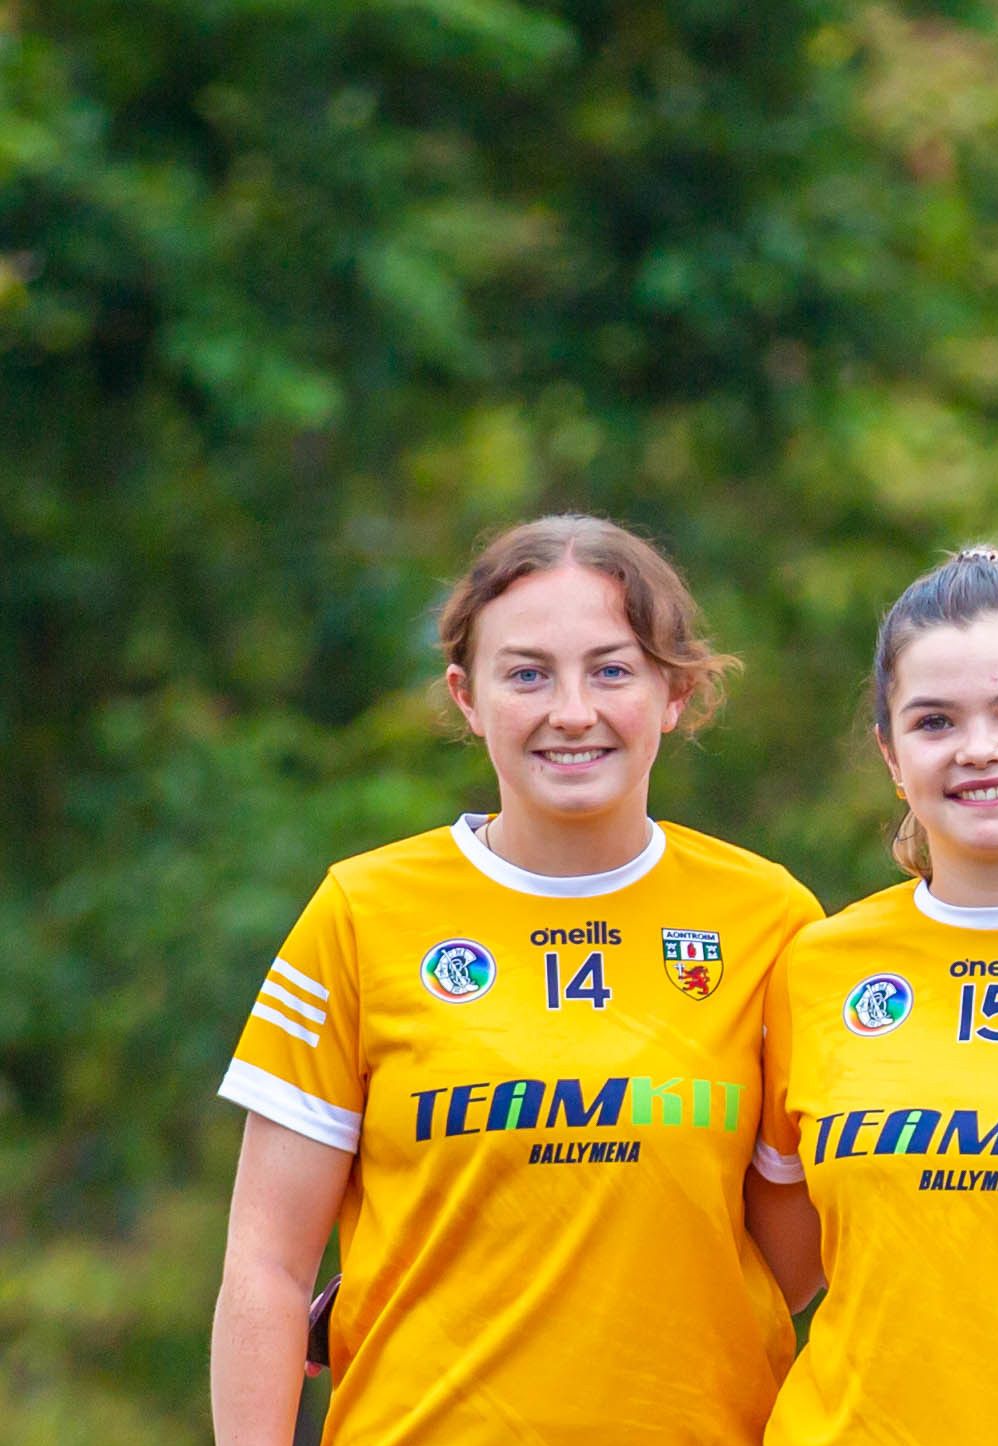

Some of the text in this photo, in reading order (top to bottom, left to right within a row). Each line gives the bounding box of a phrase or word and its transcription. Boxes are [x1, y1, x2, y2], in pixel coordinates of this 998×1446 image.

[666, 931, 716, 941] AONTROIM
[544, 953, 612, 1009] 14
[528, 1140, 641, 1165] BALLYMENA
